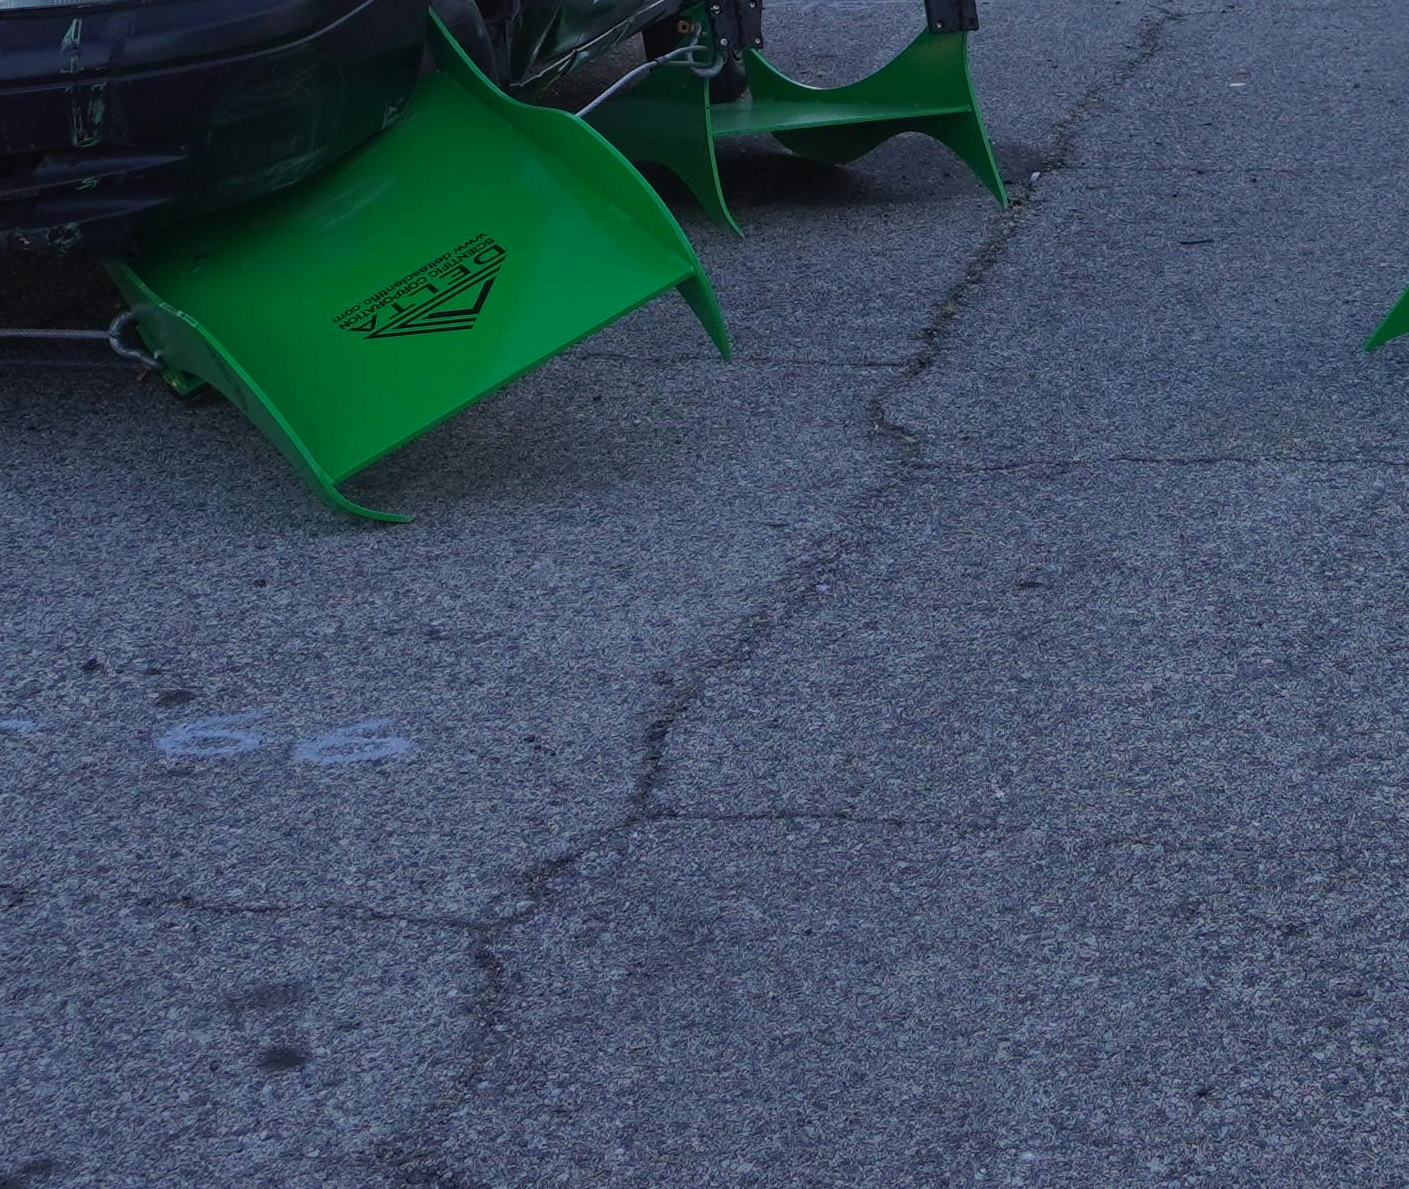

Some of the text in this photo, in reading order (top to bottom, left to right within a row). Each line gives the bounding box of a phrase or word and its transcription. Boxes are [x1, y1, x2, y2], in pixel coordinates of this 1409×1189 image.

[339, 237, 495, 330] SCIENTIFIC CORPORATION
[347, 243, 506, 332] DELTA
